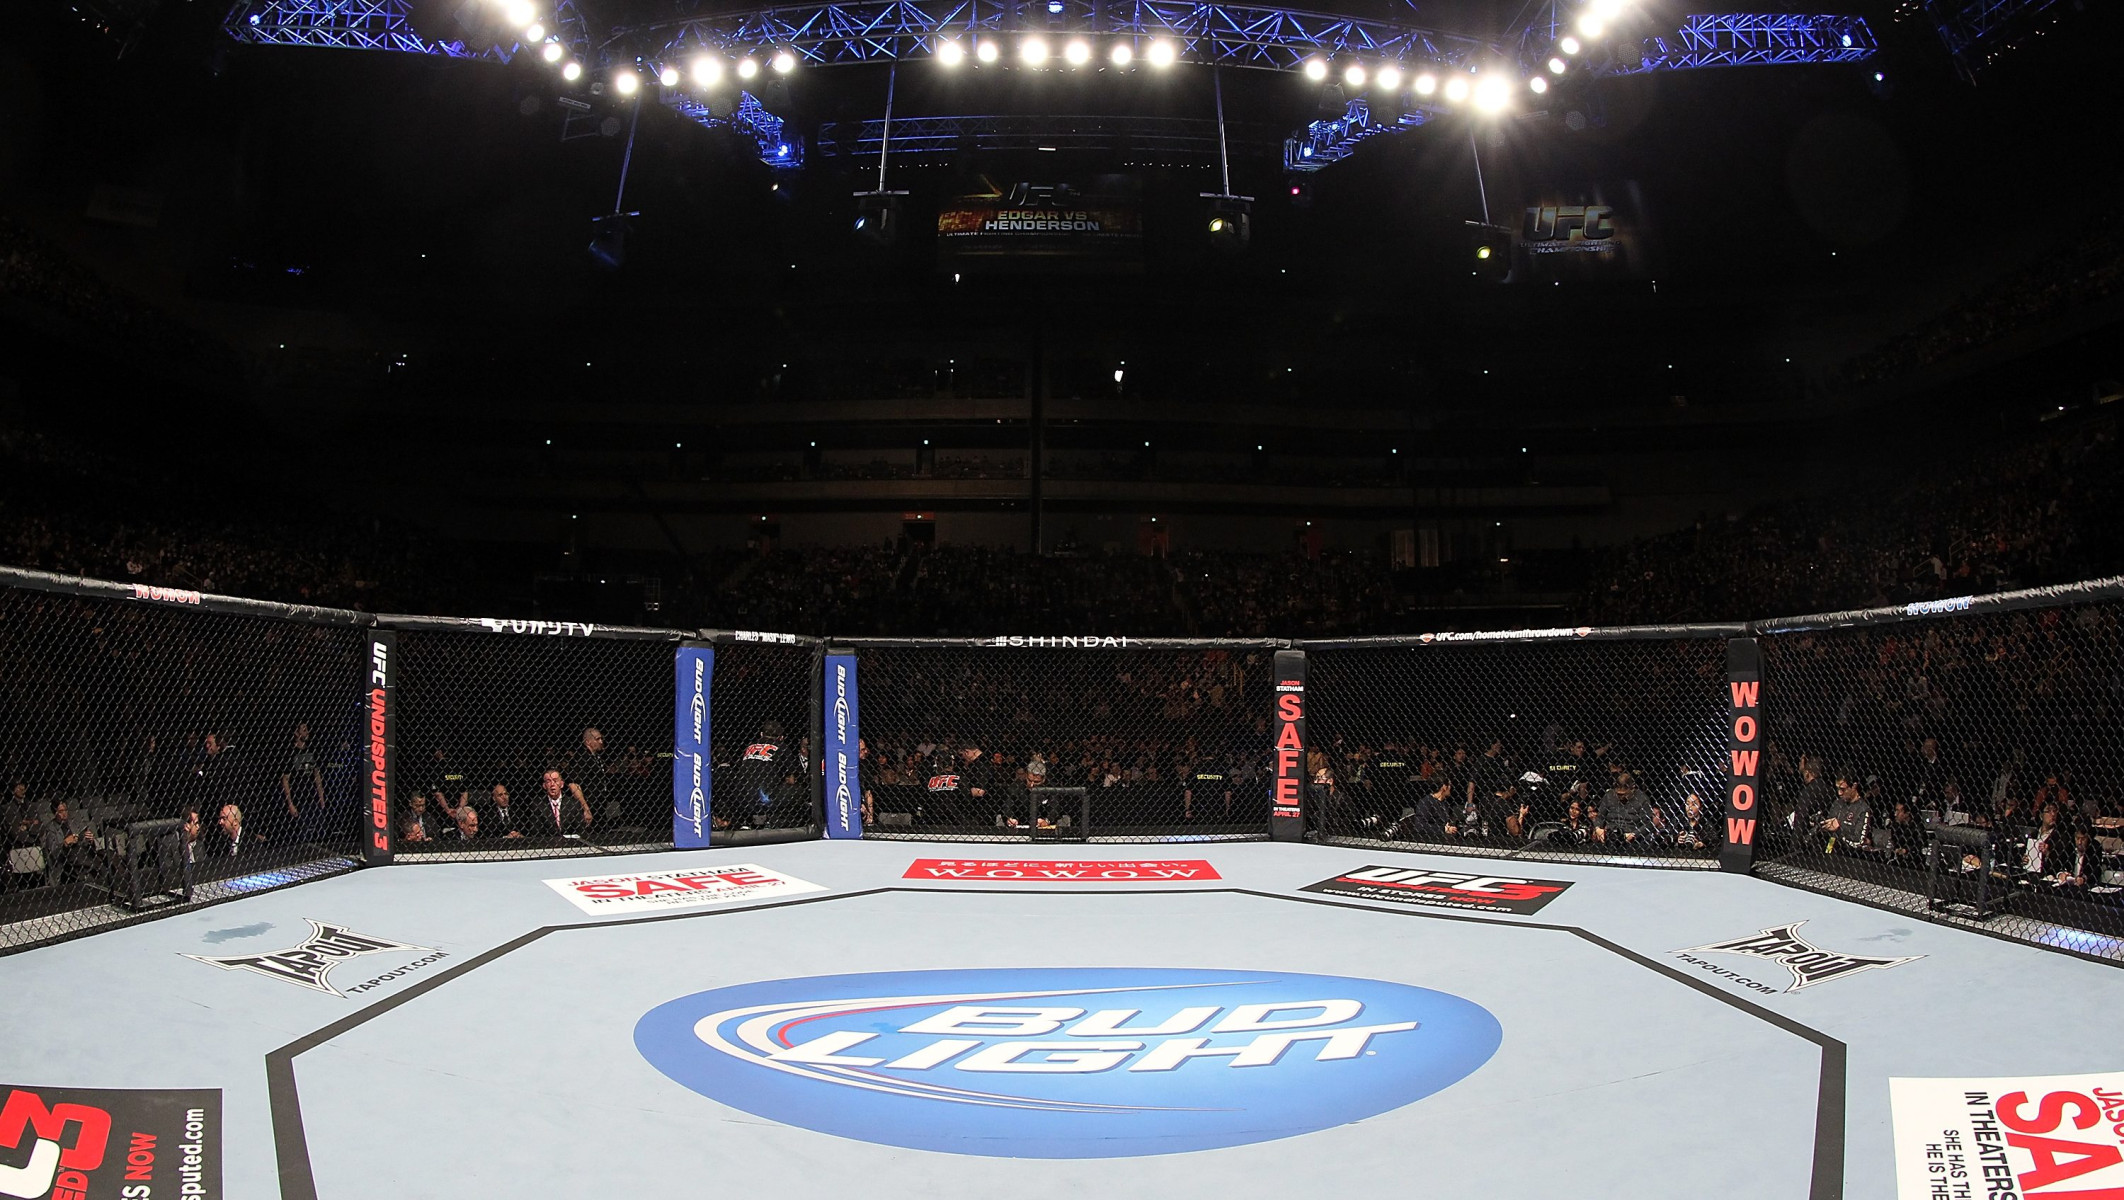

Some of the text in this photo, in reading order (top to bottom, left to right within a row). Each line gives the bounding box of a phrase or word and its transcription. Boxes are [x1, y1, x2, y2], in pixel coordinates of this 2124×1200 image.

[985, 220, 1100, 231] HENDERSON
[997, 210, 1088, 220] EDGAR VS
[1523, 206, 1615, 240] UFC
[735, 630, 759, 642] CHARLES
[1009, 636, 1127, 648] SHINDAI
[693, 657, 704, 745] BUD LIGHT
[837, 664, 847, 745] BUD LIGHT
[371, 641, 388, 850] UFC UNDISPUTED 3
[1276, 693, 1302, 806] SAFE
[1727, 681, 1760, 845] WOWOW
[692, 752, 702, 838] BUD LIGHT
[838, 752, 849, 831] BUD LIGHT
[576, 871, 781, 898] SAFE
[647, 867, 750, 880] STATHAM
[924, 866, 1200, 879] WOWOW
[1345, 867, 1528, 893] UFC
[1378, 889, 1447, 900] STORES
[1449, 896, 1497, 904] NOW
[215, 926, 401, 985] TAPOUT
[346, 951, 451, 995] TAPOUT.COM
[1675, 952, 1778, 995] TAPOUT.COM
[1712, 927, 1897, 982] TAPOUT
[897, 999, 1366, 1038] BUD
[768, 1020, 1419, 1072] LIGHT
[1964, 1092, 1991, 1106] IN
[124, 1132, 157, 1180] NOW
[1926, 1143, 1950, 1200] HE IS THE
[1943, 1129, 1972, 1200] SHE HAS TH
